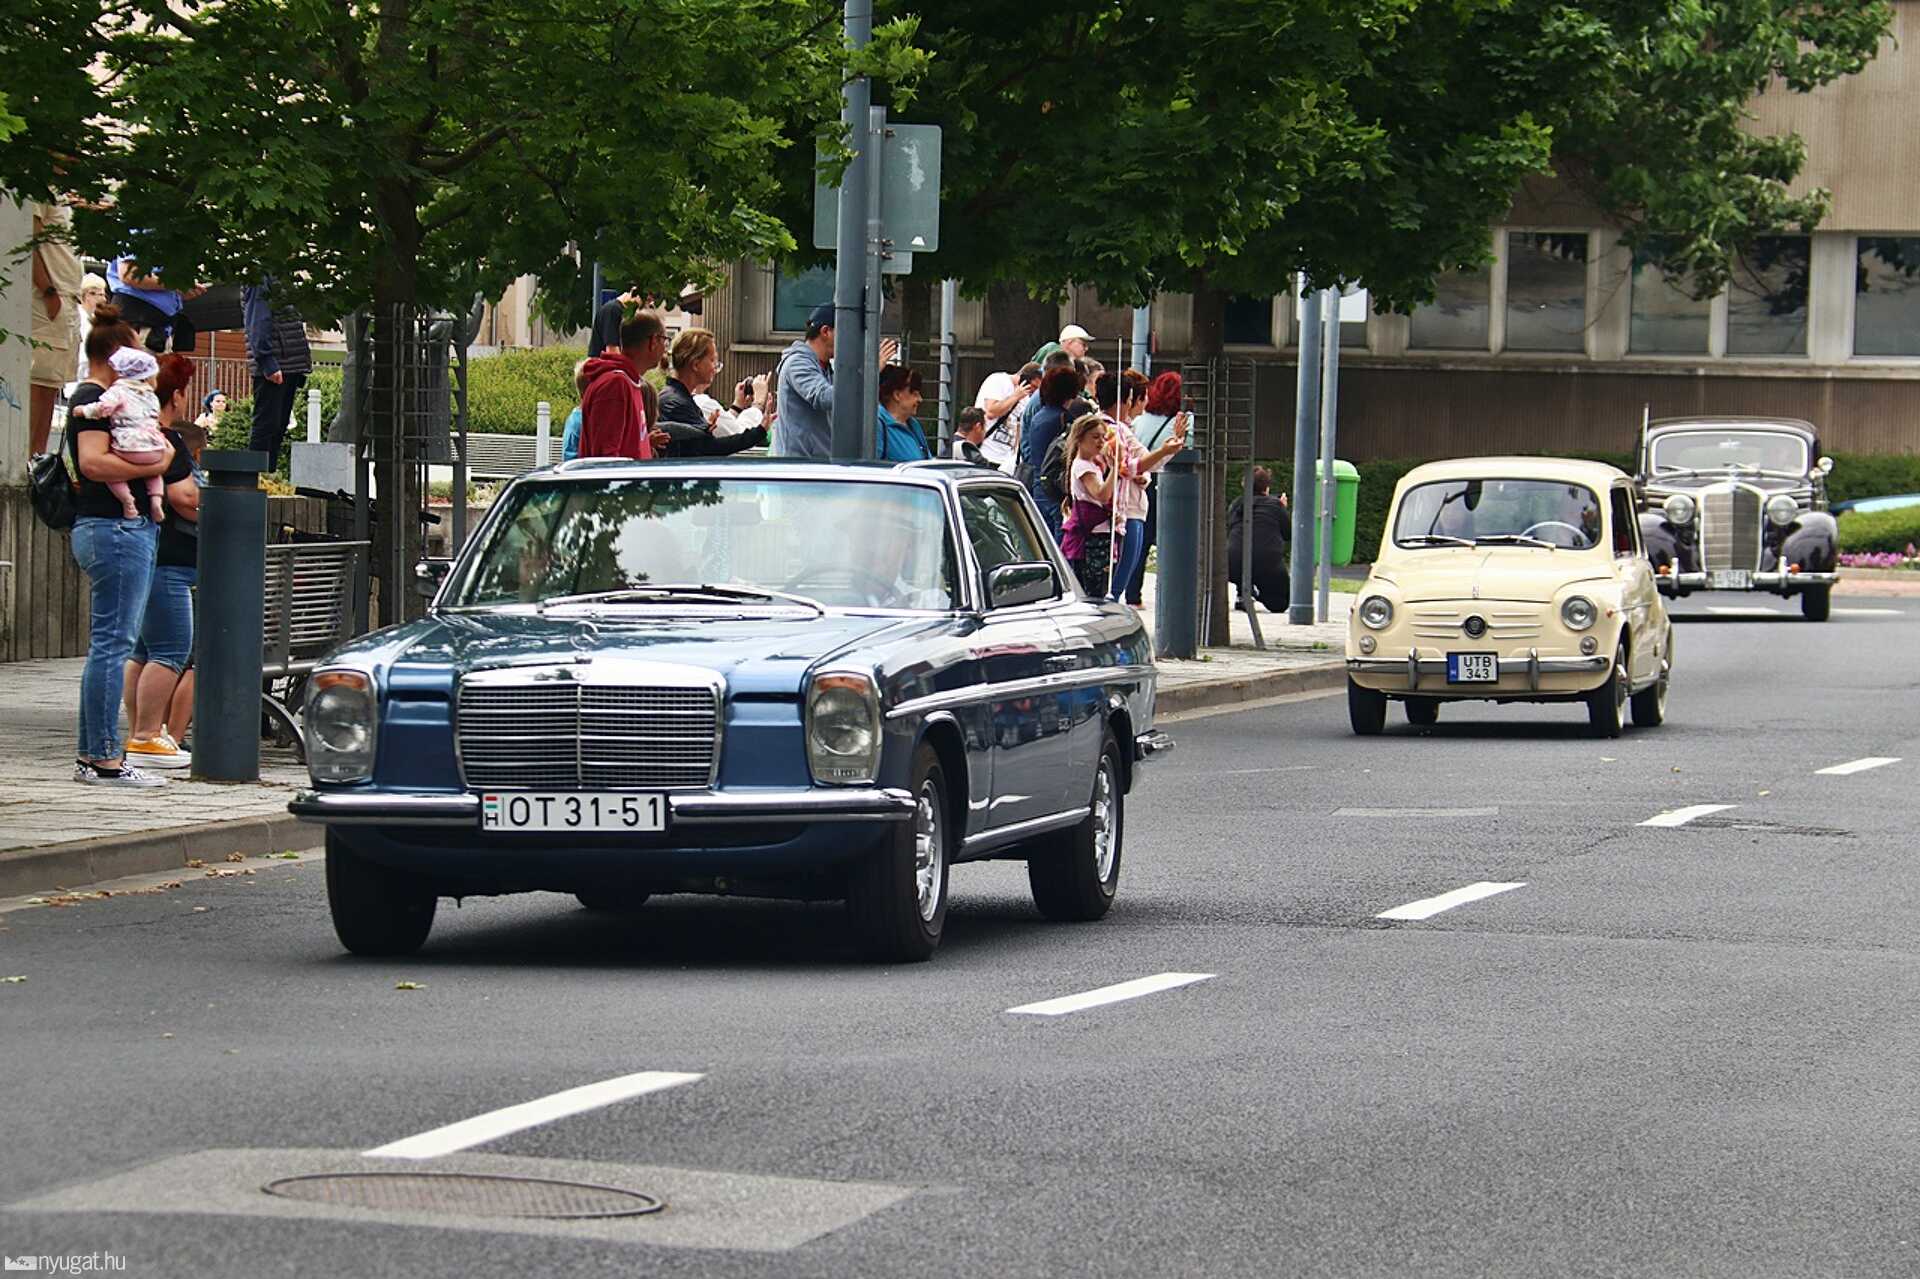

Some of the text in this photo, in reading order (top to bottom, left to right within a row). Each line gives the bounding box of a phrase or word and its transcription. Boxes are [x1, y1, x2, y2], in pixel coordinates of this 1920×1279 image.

[1463, 656, 1492, 667] UTB
[1466, 668, 1489, 679] 343
[485, 813, 498, 826] H
